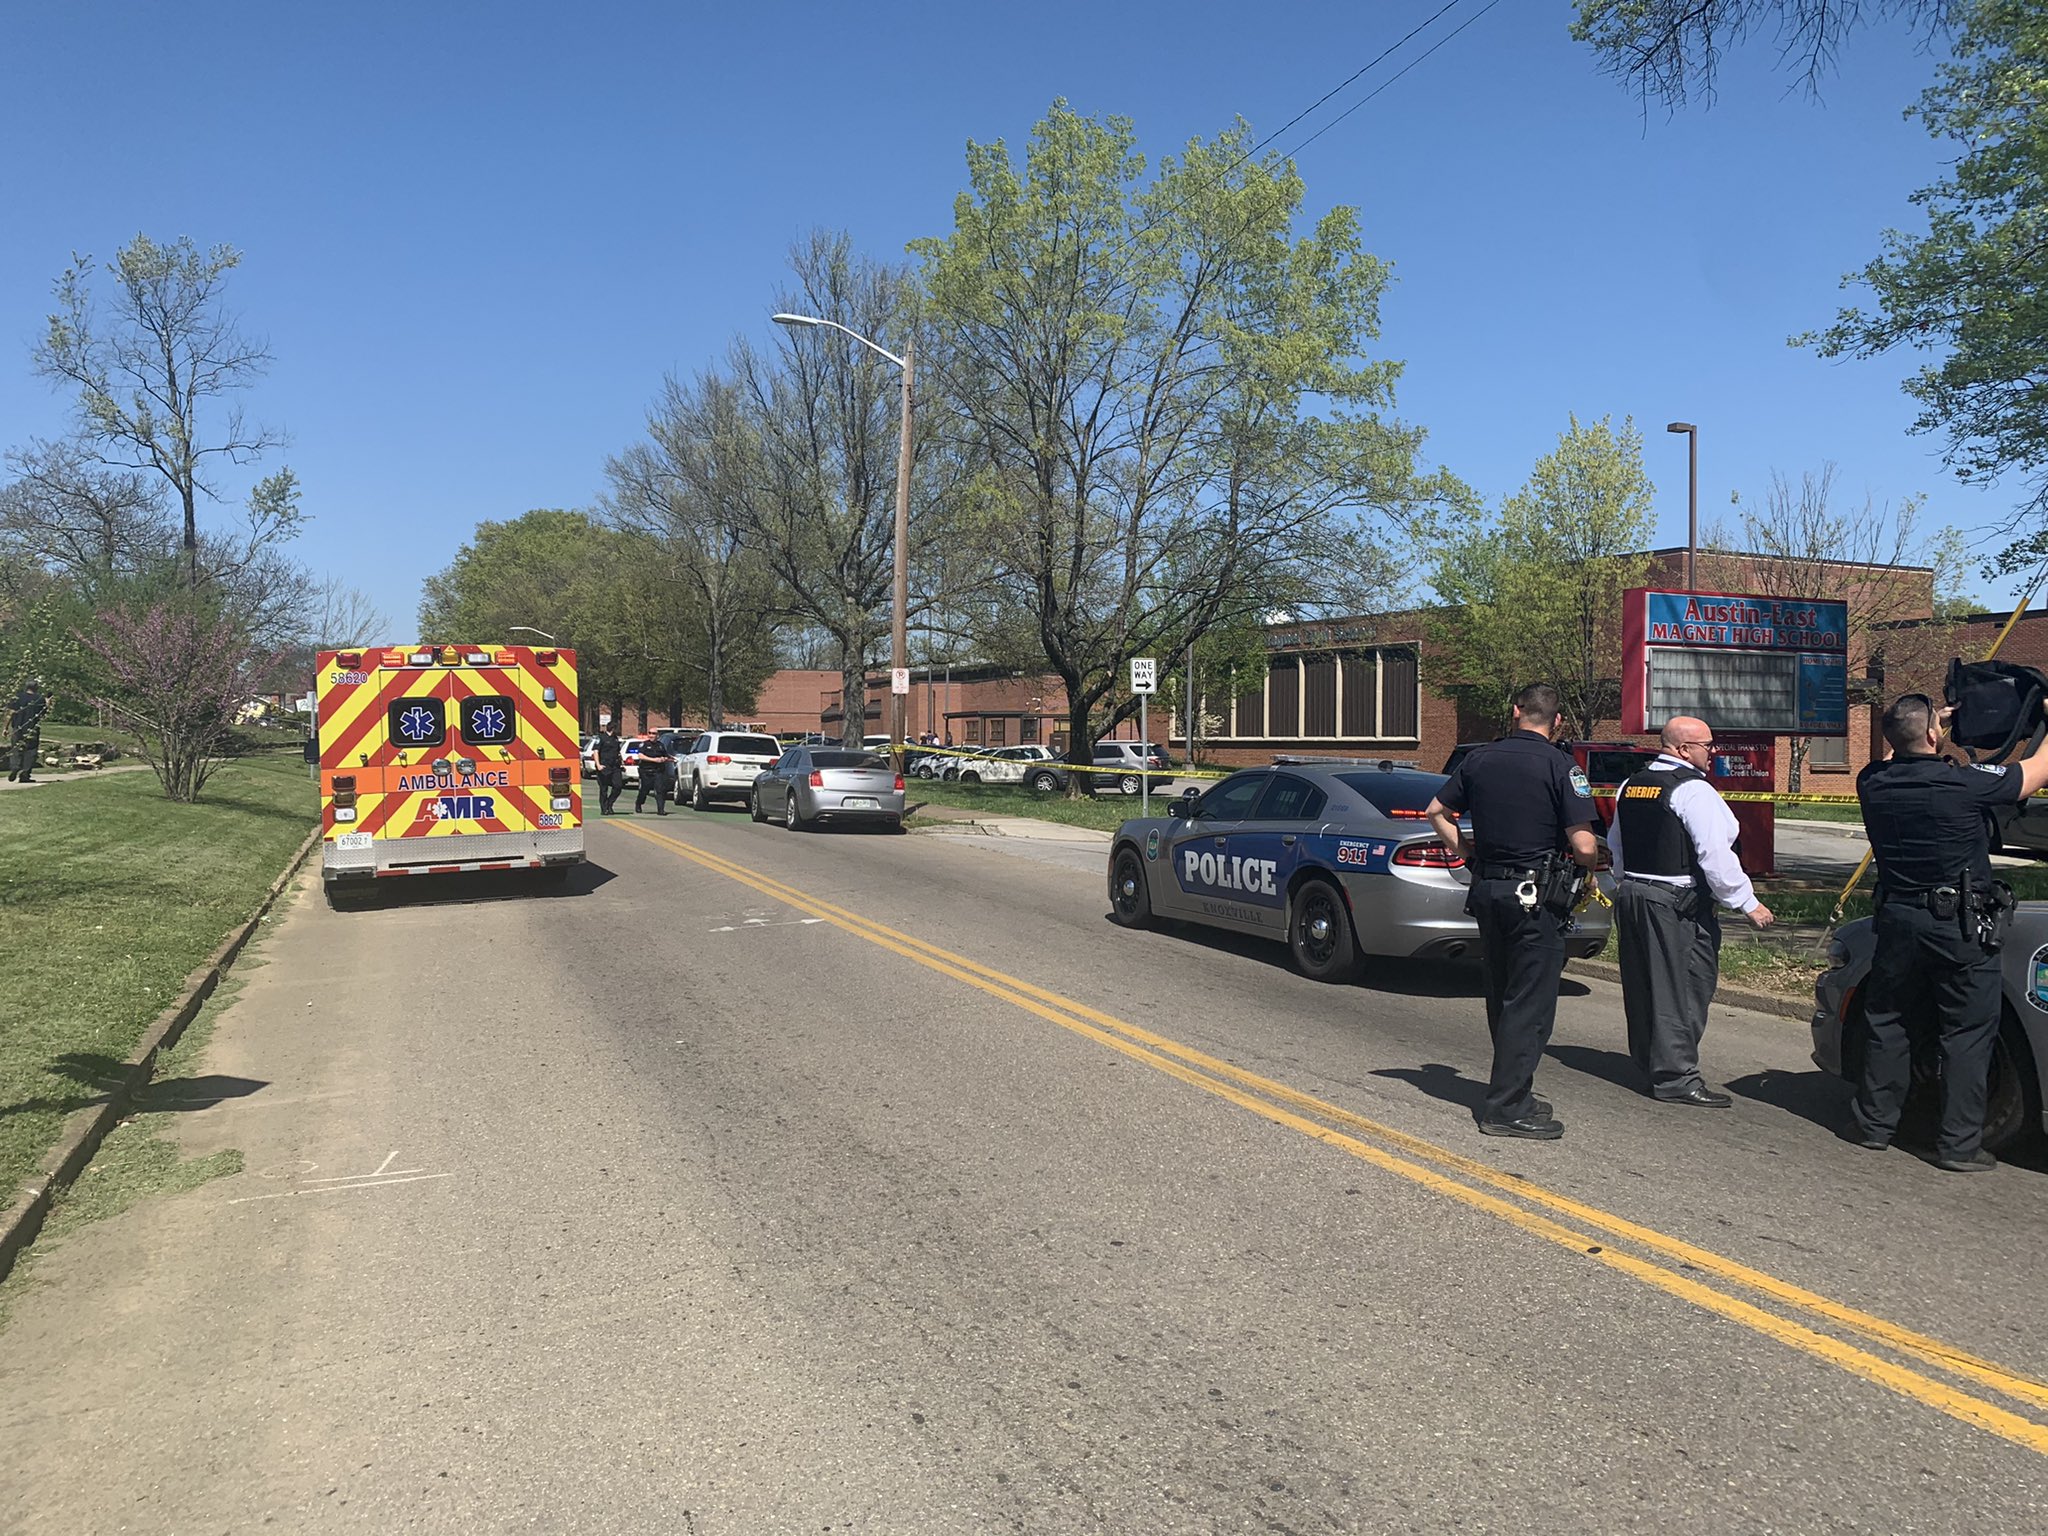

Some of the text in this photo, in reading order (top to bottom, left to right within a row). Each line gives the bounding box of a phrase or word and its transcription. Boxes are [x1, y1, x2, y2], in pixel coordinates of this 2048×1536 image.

[1683, 597, 1817, 628] Austin-East
[1651, 622, 1844, 648] MAGNET HIGH SCHOOL
[1134, 661, 1153, 670] ONE
[1134, 671, 1153, 679] WAY
[330, 672, 368, 685] 58620
[398, 772, 508, 791] AMBULANCE
[1624, 786, 1662, 799] SHERIFF
[414, 795, 495, 821] AMR
[539, 813, 563, 826] 58620
[1339, 840, 1370, 848] EMERGENCY
[1337, 846, 1367, 866] 911
[1184, 850, 1277, 896] POLICE
[1202, 902, 1264, 924] KNOXVILLE
